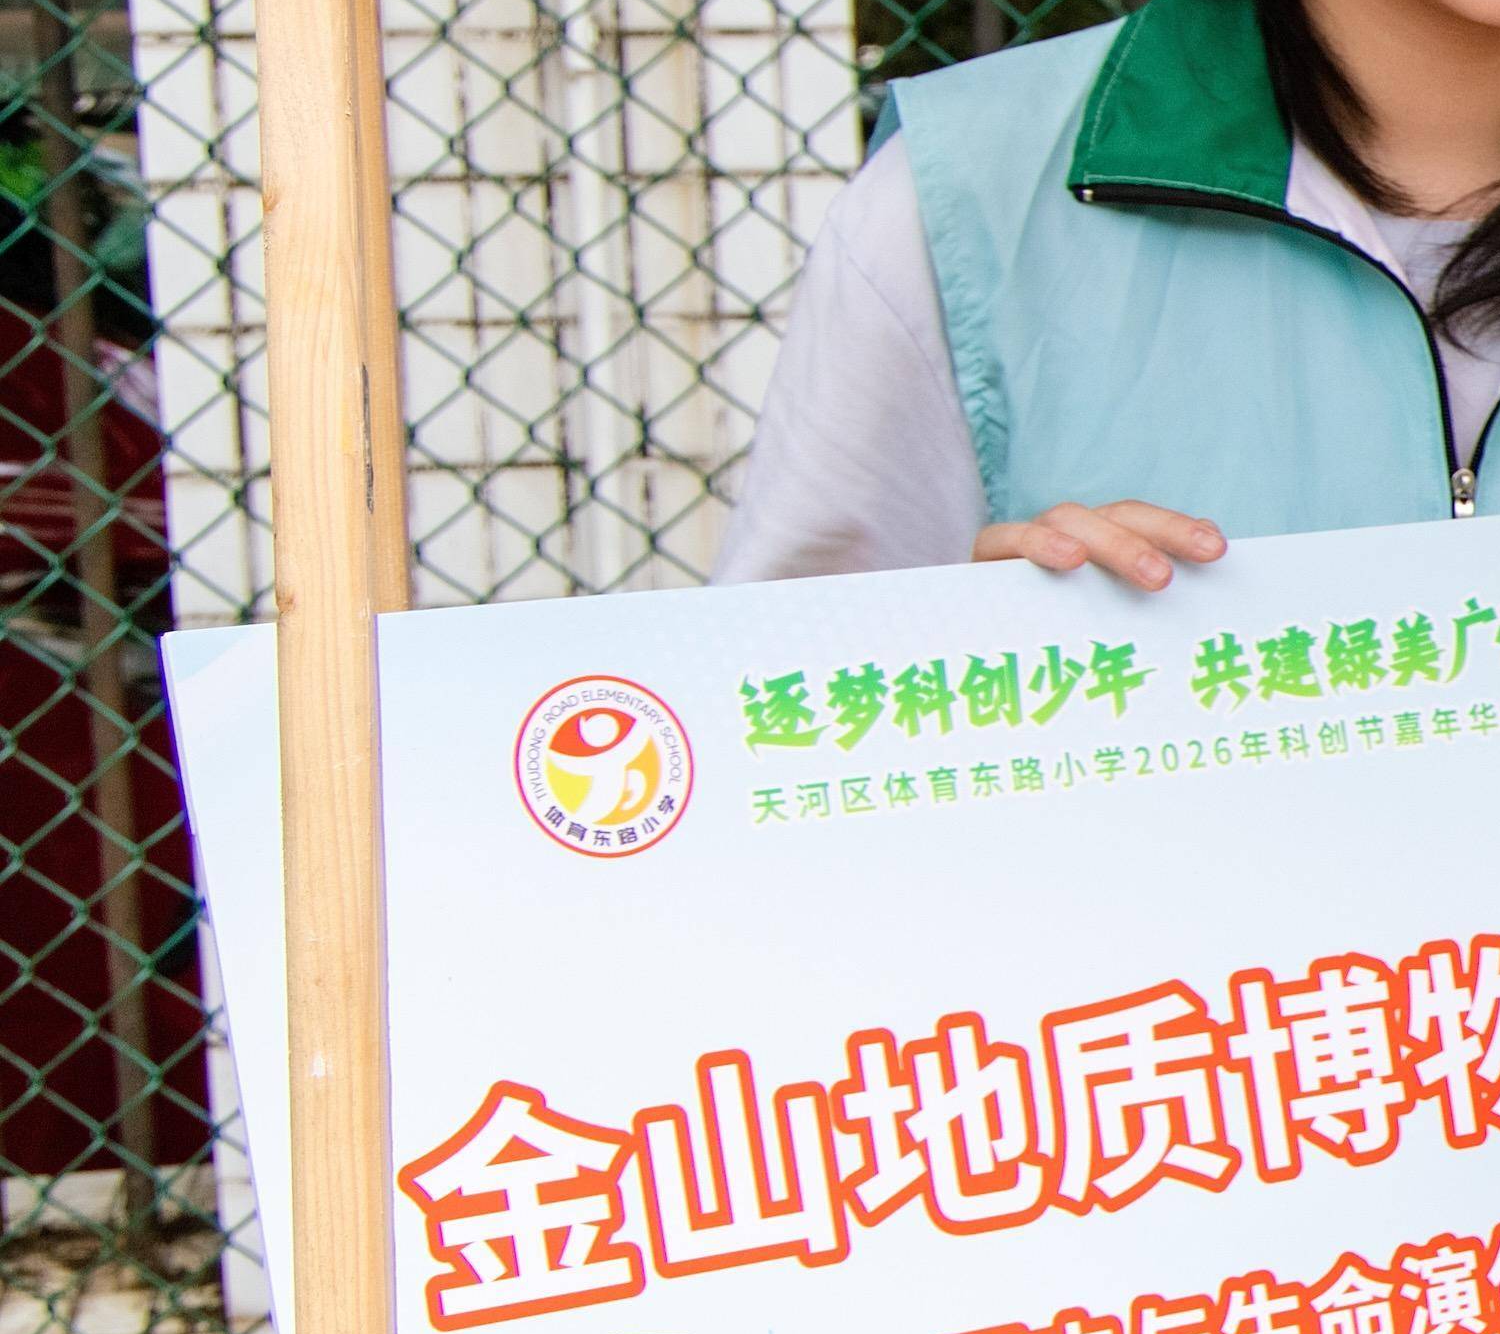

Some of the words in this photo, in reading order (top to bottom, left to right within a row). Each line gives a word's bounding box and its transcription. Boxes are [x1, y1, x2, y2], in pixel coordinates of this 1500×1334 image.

[542, 694, 579, 725] ROAD
[580, 688, 665, 726] ELEMENTARY
[659, 725, 683, 785] SCHOOL
[738, 638, 1158, 755] 逐梦科创少年
[544, 794, 676, 847] 体育东路小学
